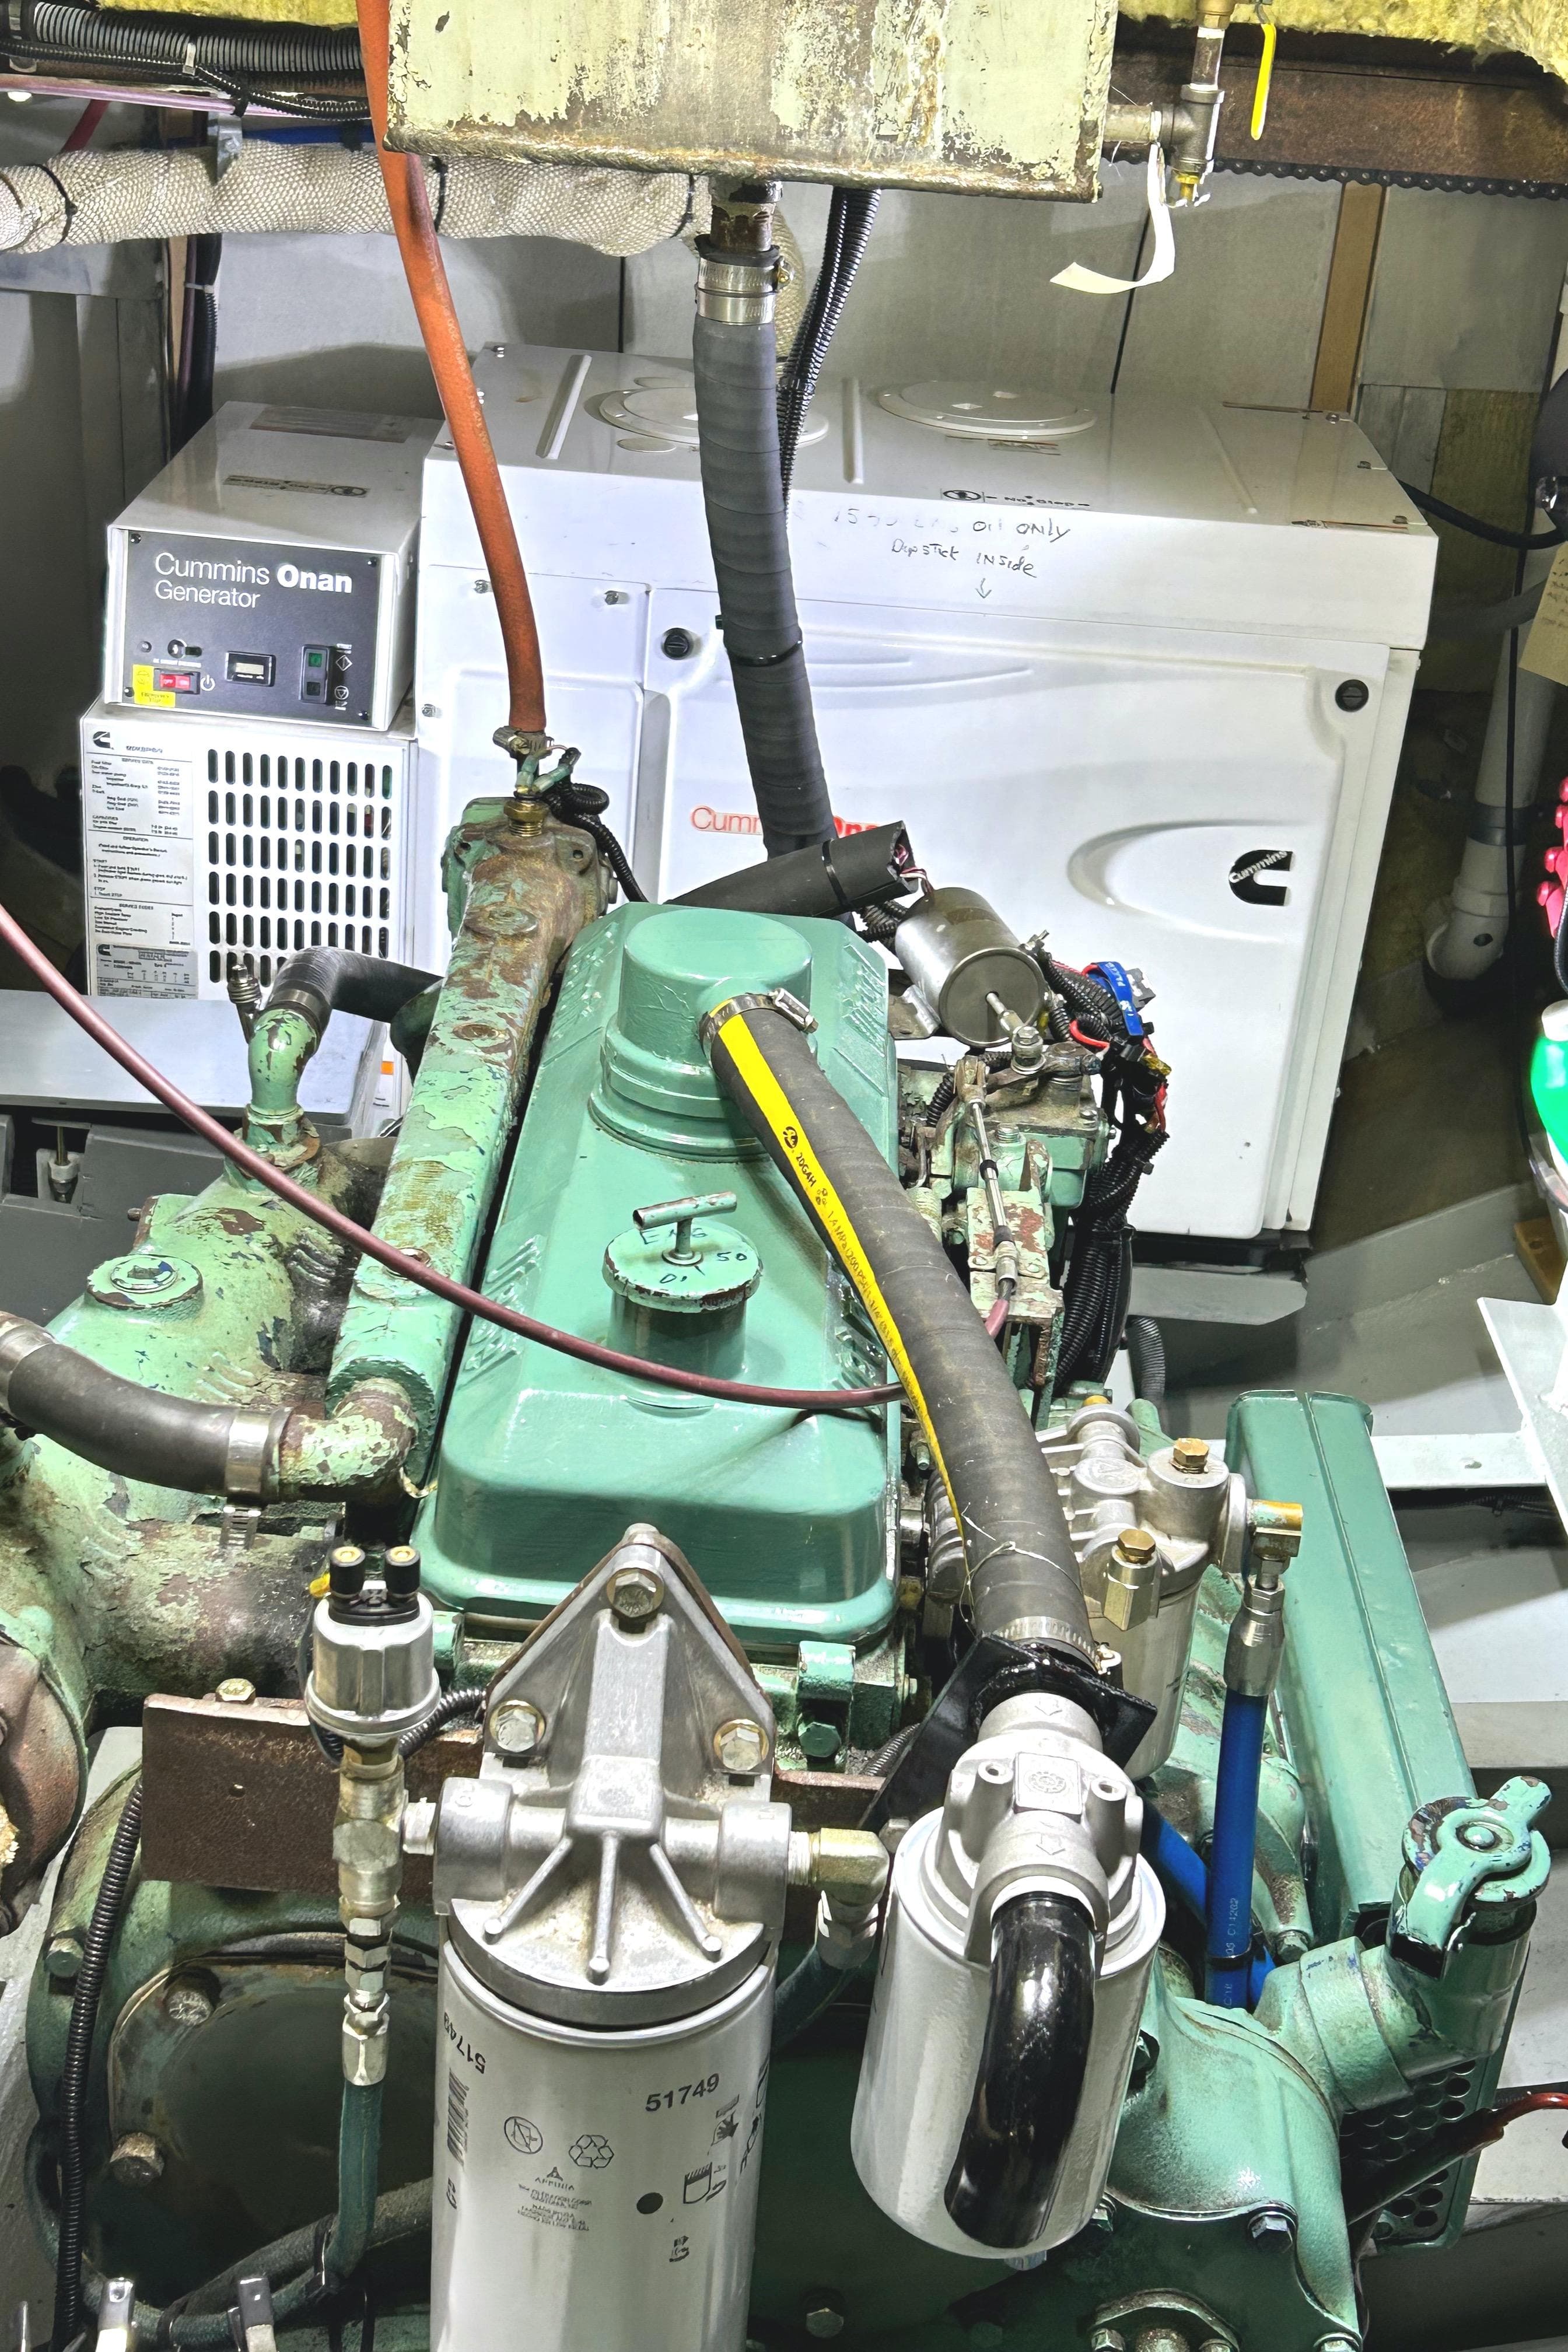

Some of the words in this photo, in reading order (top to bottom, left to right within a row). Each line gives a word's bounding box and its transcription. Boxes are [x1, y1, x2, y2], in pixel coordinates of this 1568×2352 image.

[155, 552, 270, 586] Cummins
[277, 564, 353, 594] Onan
[155, 579, 261, 608] Generator
[1228, 850, 1288, 884] Cummins
[645, 2073, 719, 2112] 51749
